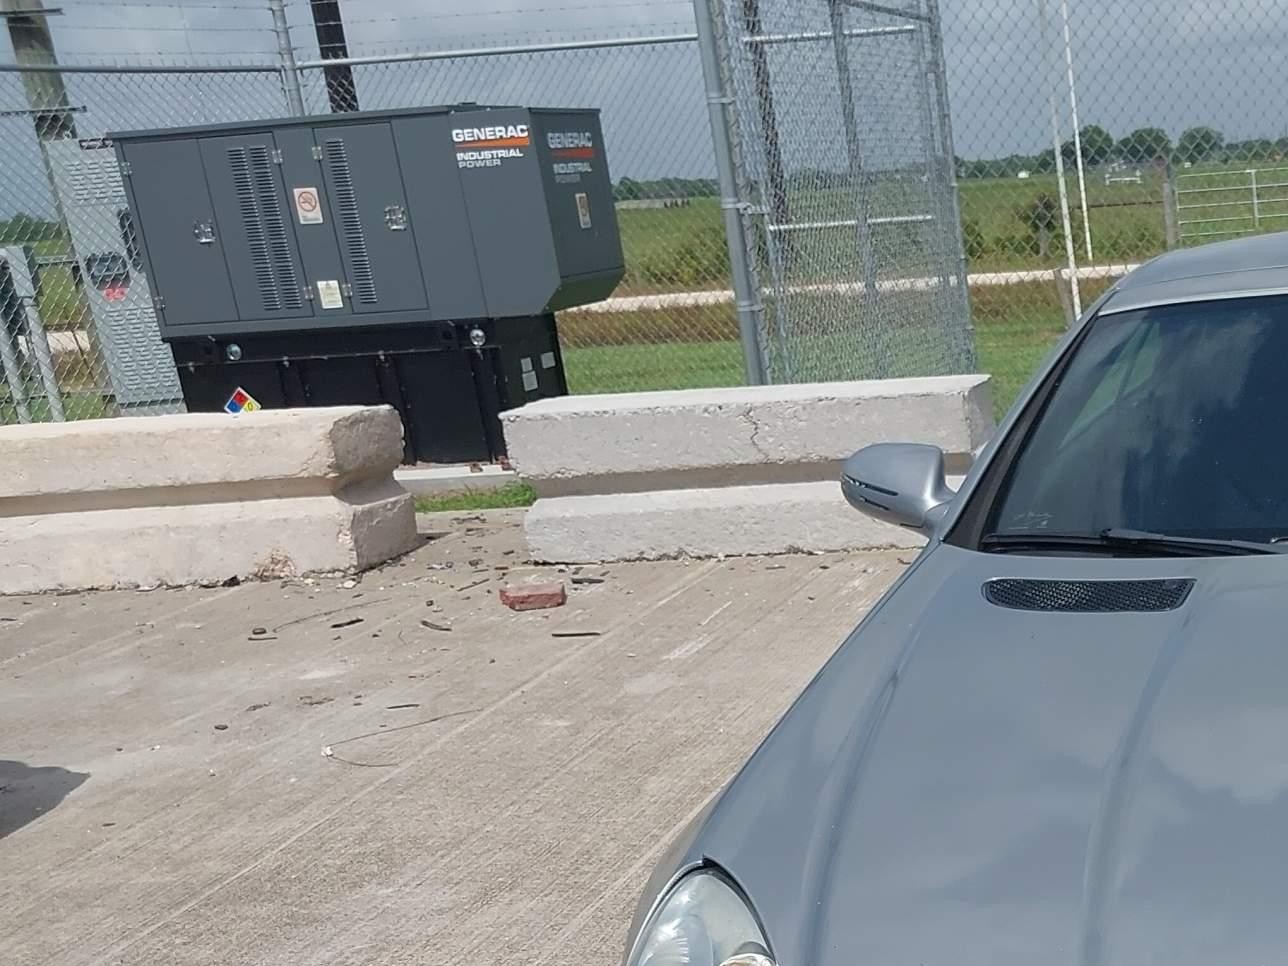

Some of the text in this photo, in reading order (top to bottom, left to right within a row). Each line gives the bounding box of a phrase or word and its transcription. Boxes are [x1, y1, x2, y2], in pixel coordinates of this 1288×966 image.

[452, 125, 528, 142] GENERAC
[547, 132, 592, 148] GENERAC
[456, 148, 524, 161] INDUSTRIAL
[458, 158, 502, 169] POWER
[553, 162, 593, 174] INDUSTRIAL
